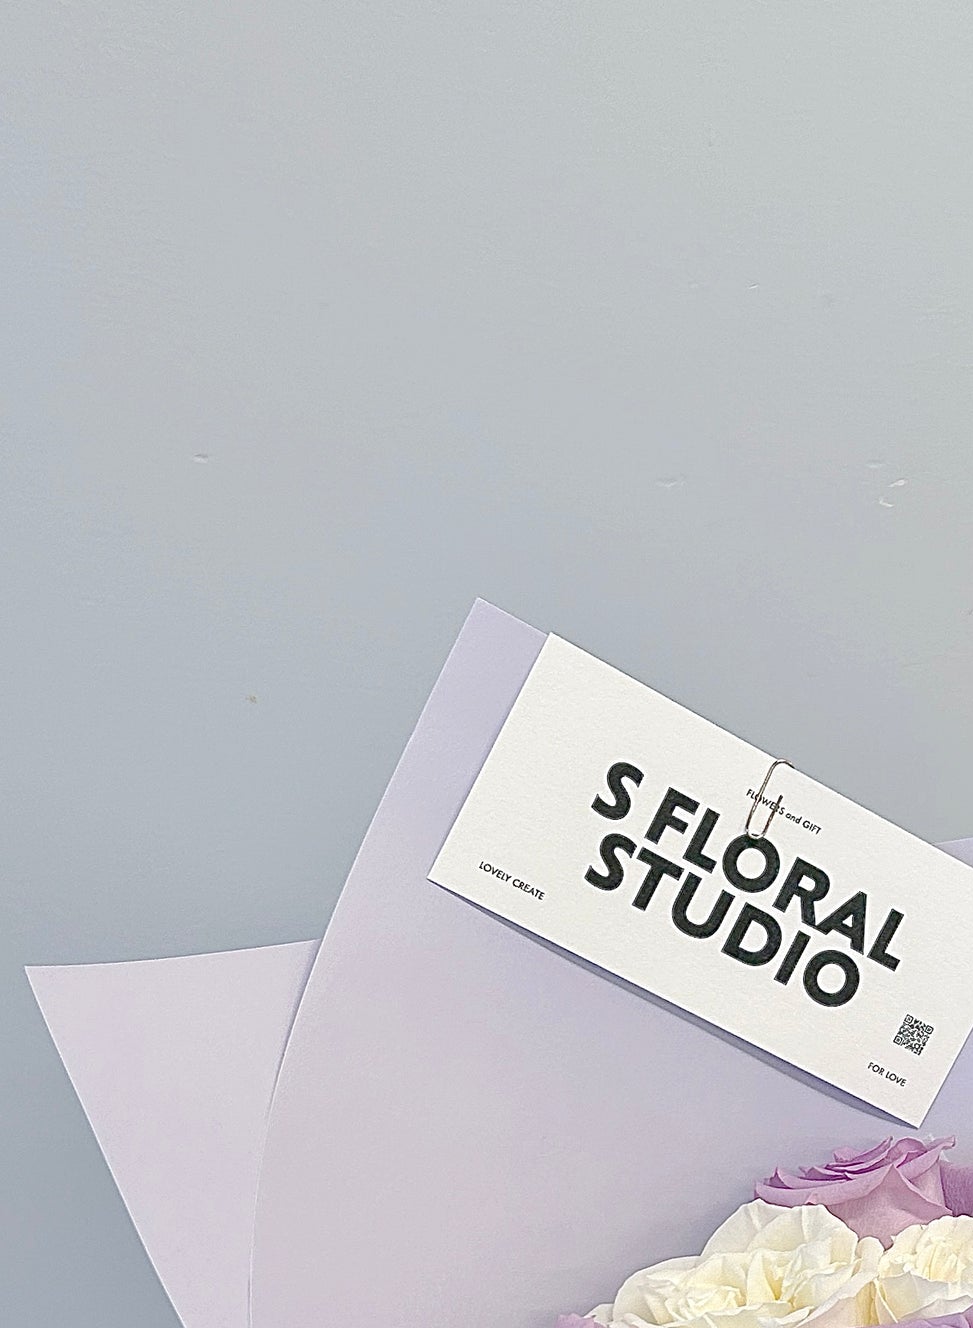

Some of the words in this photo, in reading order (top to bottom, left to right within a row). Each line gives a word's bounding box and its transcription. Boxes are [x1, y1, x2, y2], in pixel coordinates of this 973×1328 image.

[785, 812, 803, 824] and
[802, 820, 822, 835] GIFT
[478, 861, 512, 882] LOVELY
[512, 878, 546, 900] CREATE
[591, 762, 645, 821] S
[644, 786, 905, 972] FLORAL
[584, 833, 860, 1008] STUDIO
[867, 1061, 885, 1076] FOR
[885, 1071, 907, 1087] LOVE
